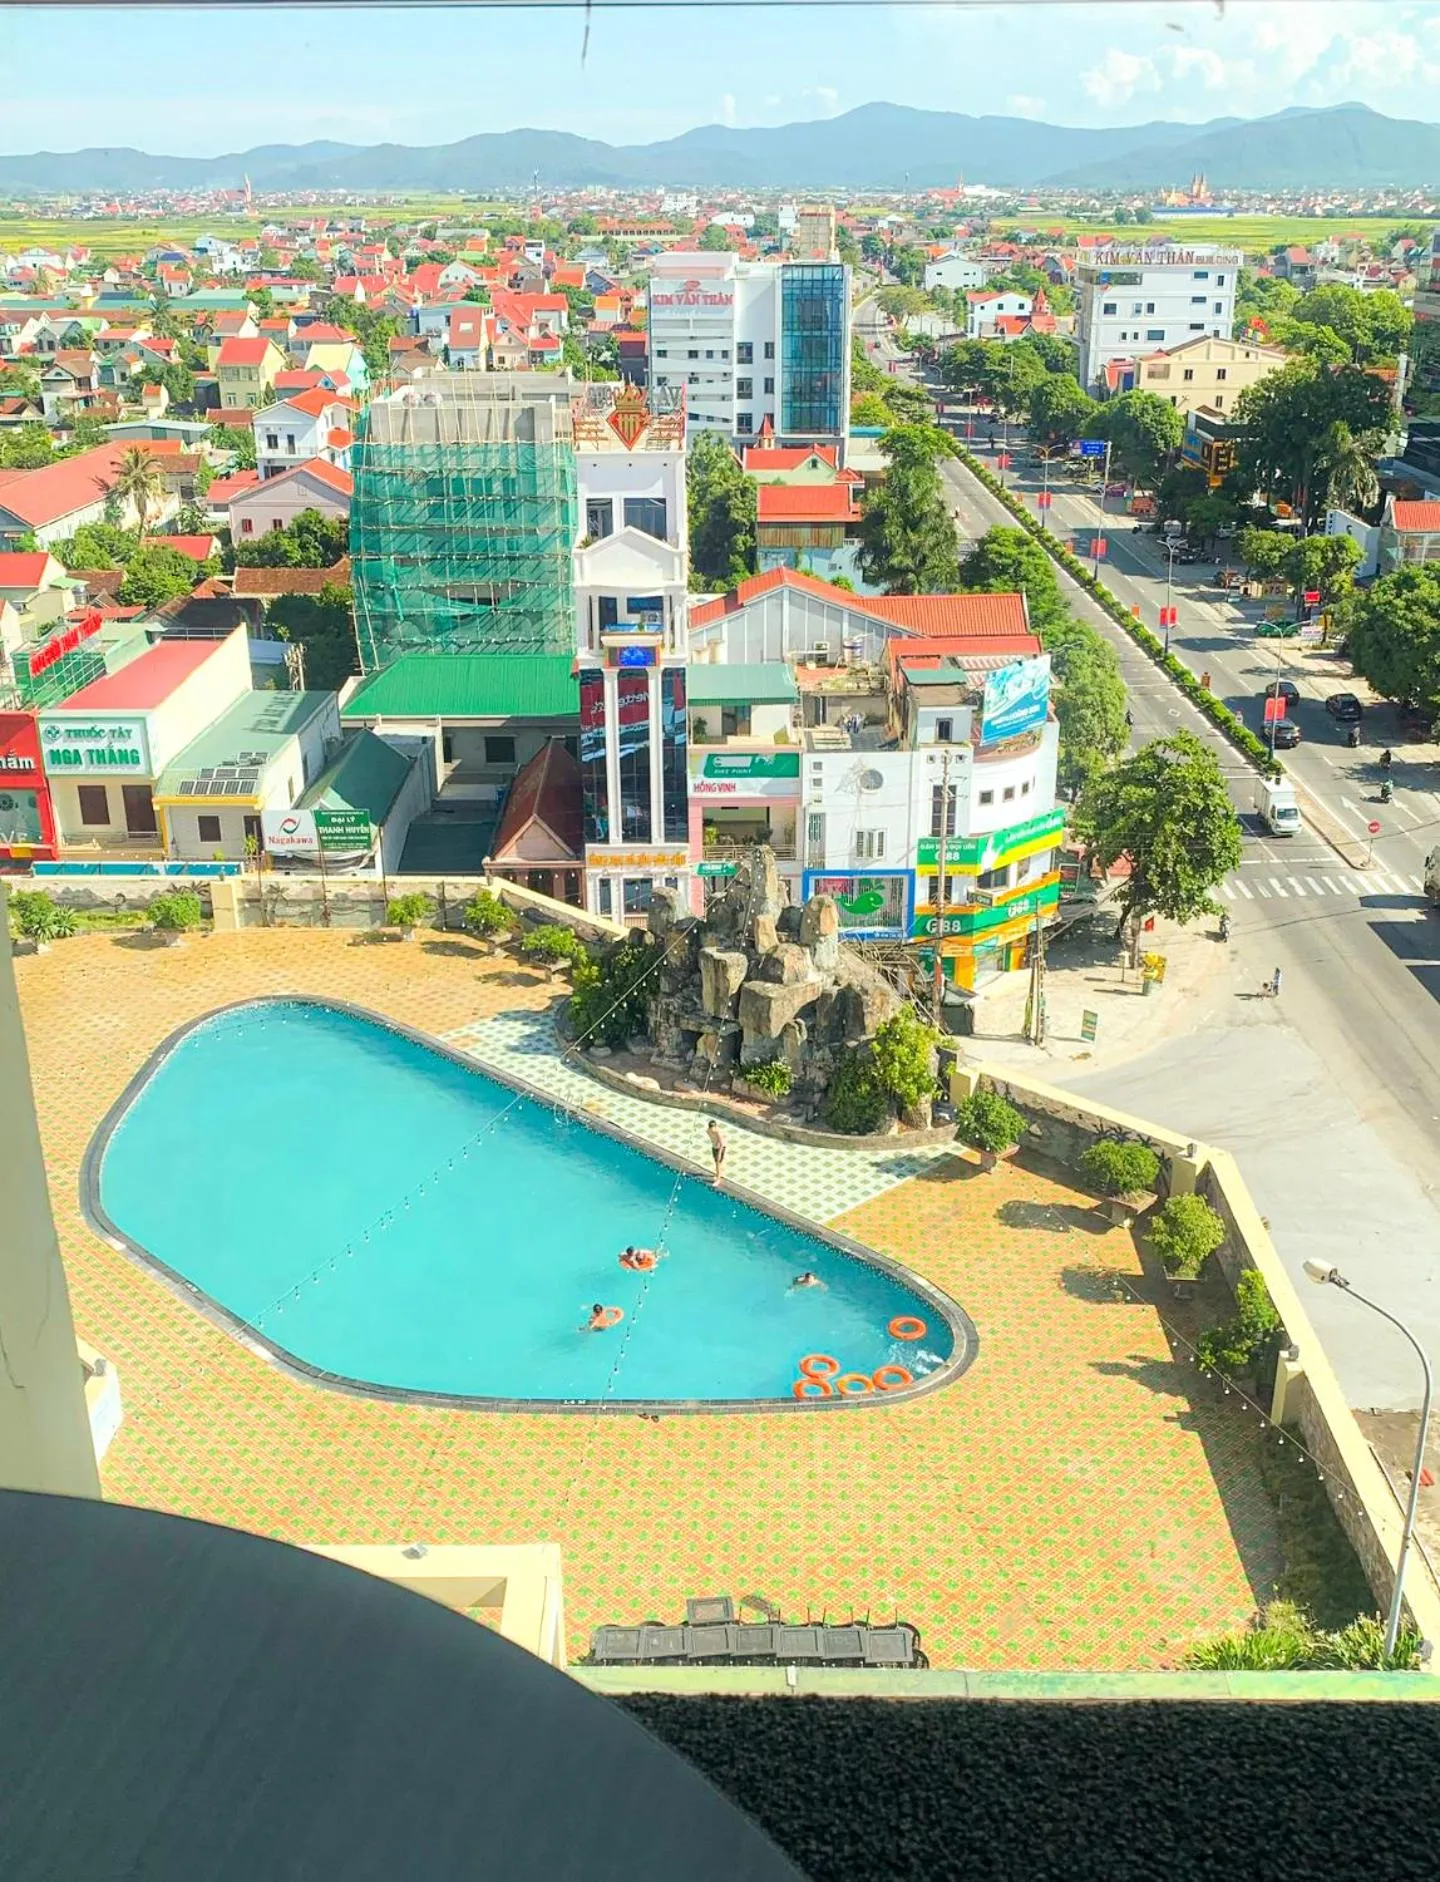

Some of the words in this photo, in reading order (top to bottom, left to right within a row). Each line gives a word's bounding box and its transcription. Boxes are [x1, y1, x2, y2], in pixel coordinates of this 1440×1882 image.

[1096, 250, 1119, 265] KIM
[652, 294, 673, 306] KIM
[64, 725, 106, 739] THUỐC
[48, 748, 83, 766] NGA
[268, 835, 313, 845] Nagakawa
